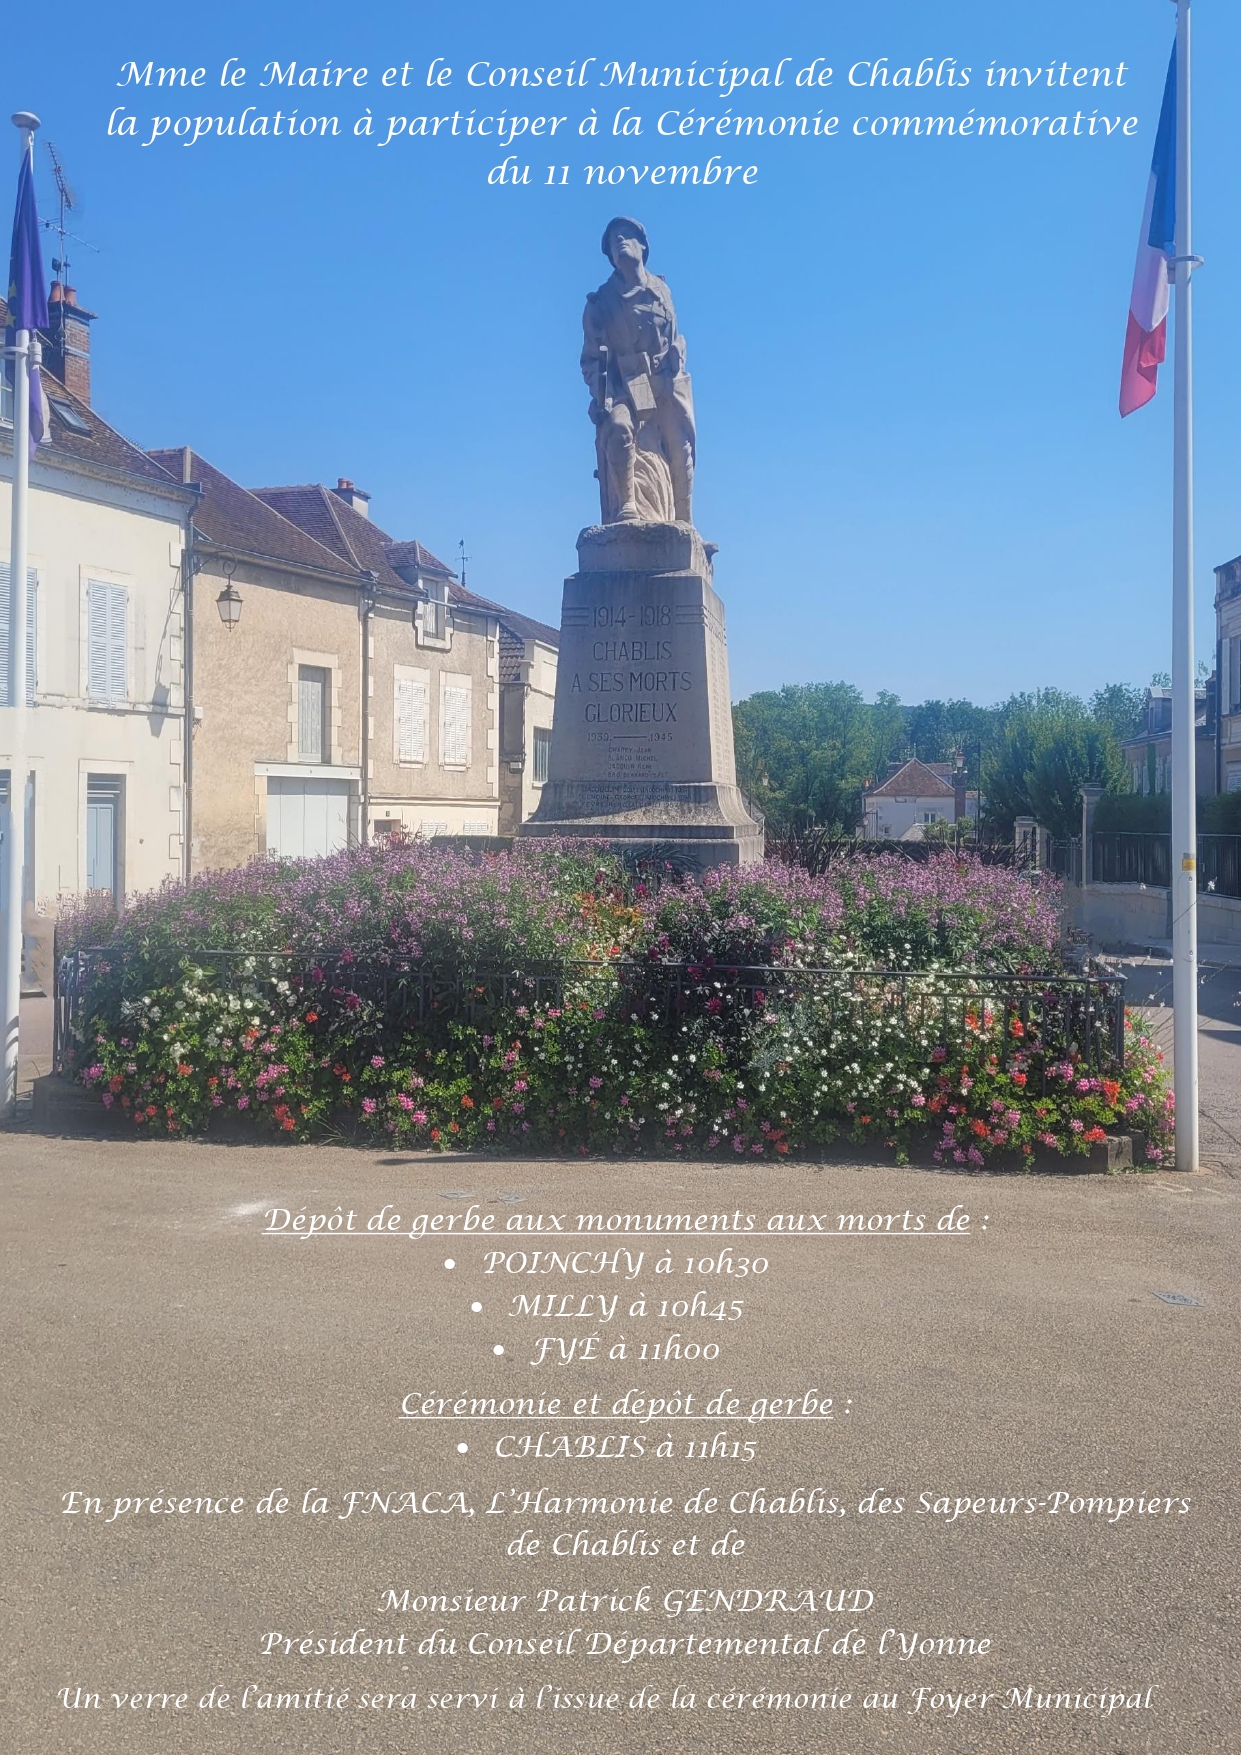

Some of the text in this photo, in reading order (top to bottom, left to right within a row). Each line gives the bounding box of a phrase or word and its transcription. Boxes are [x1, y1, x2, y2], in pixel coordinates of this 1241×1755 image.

[592, 641, 673, 661] CHABLIS
[571, 671, 692, 693] A SES MORTS
[584, 702, 678, 723] GLORIEUX
